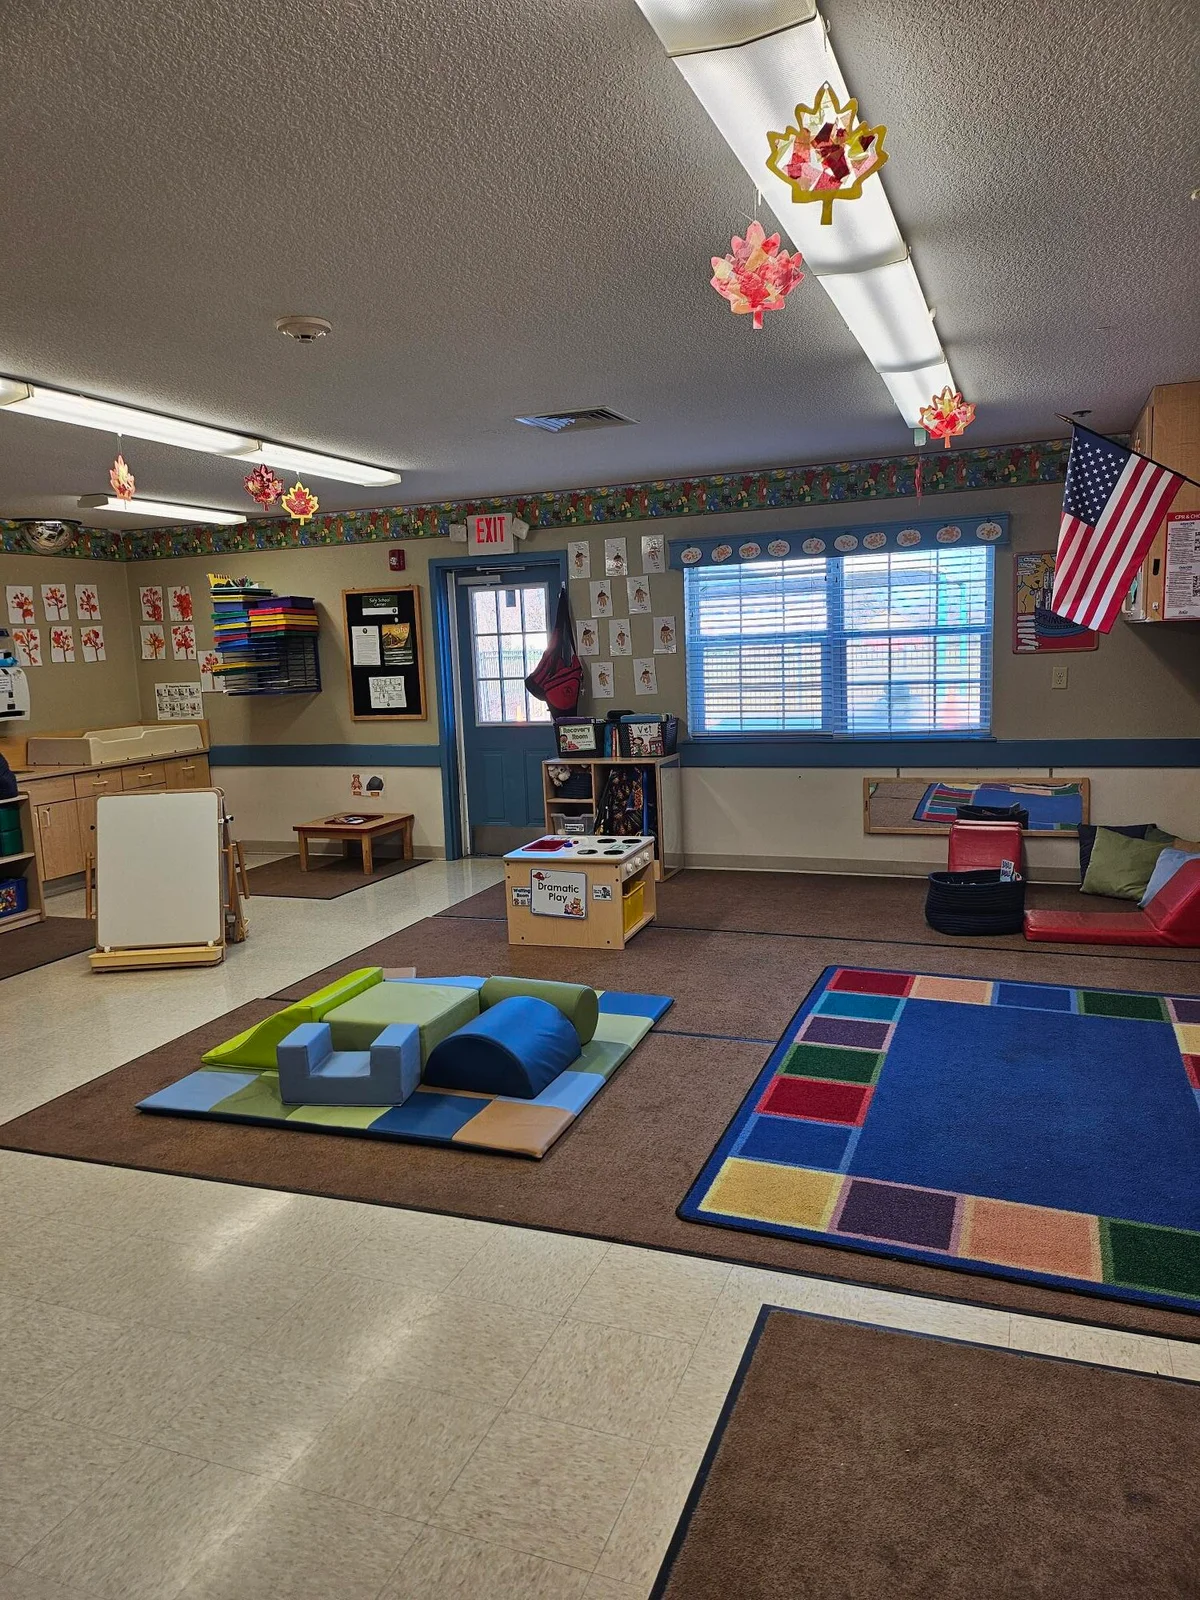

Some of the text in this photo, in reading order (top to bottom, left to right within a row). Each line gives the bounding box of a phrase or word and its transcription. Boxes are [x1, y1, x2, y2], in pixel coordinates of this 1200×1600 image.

[476, 516, 505, 543] EXIT
[563, 726, 591, 734] Recovery
[637, 725, 652, 734] Vet
[538, 882, 579, 894] Dramatic
[548, 893, 568, 904] Play
